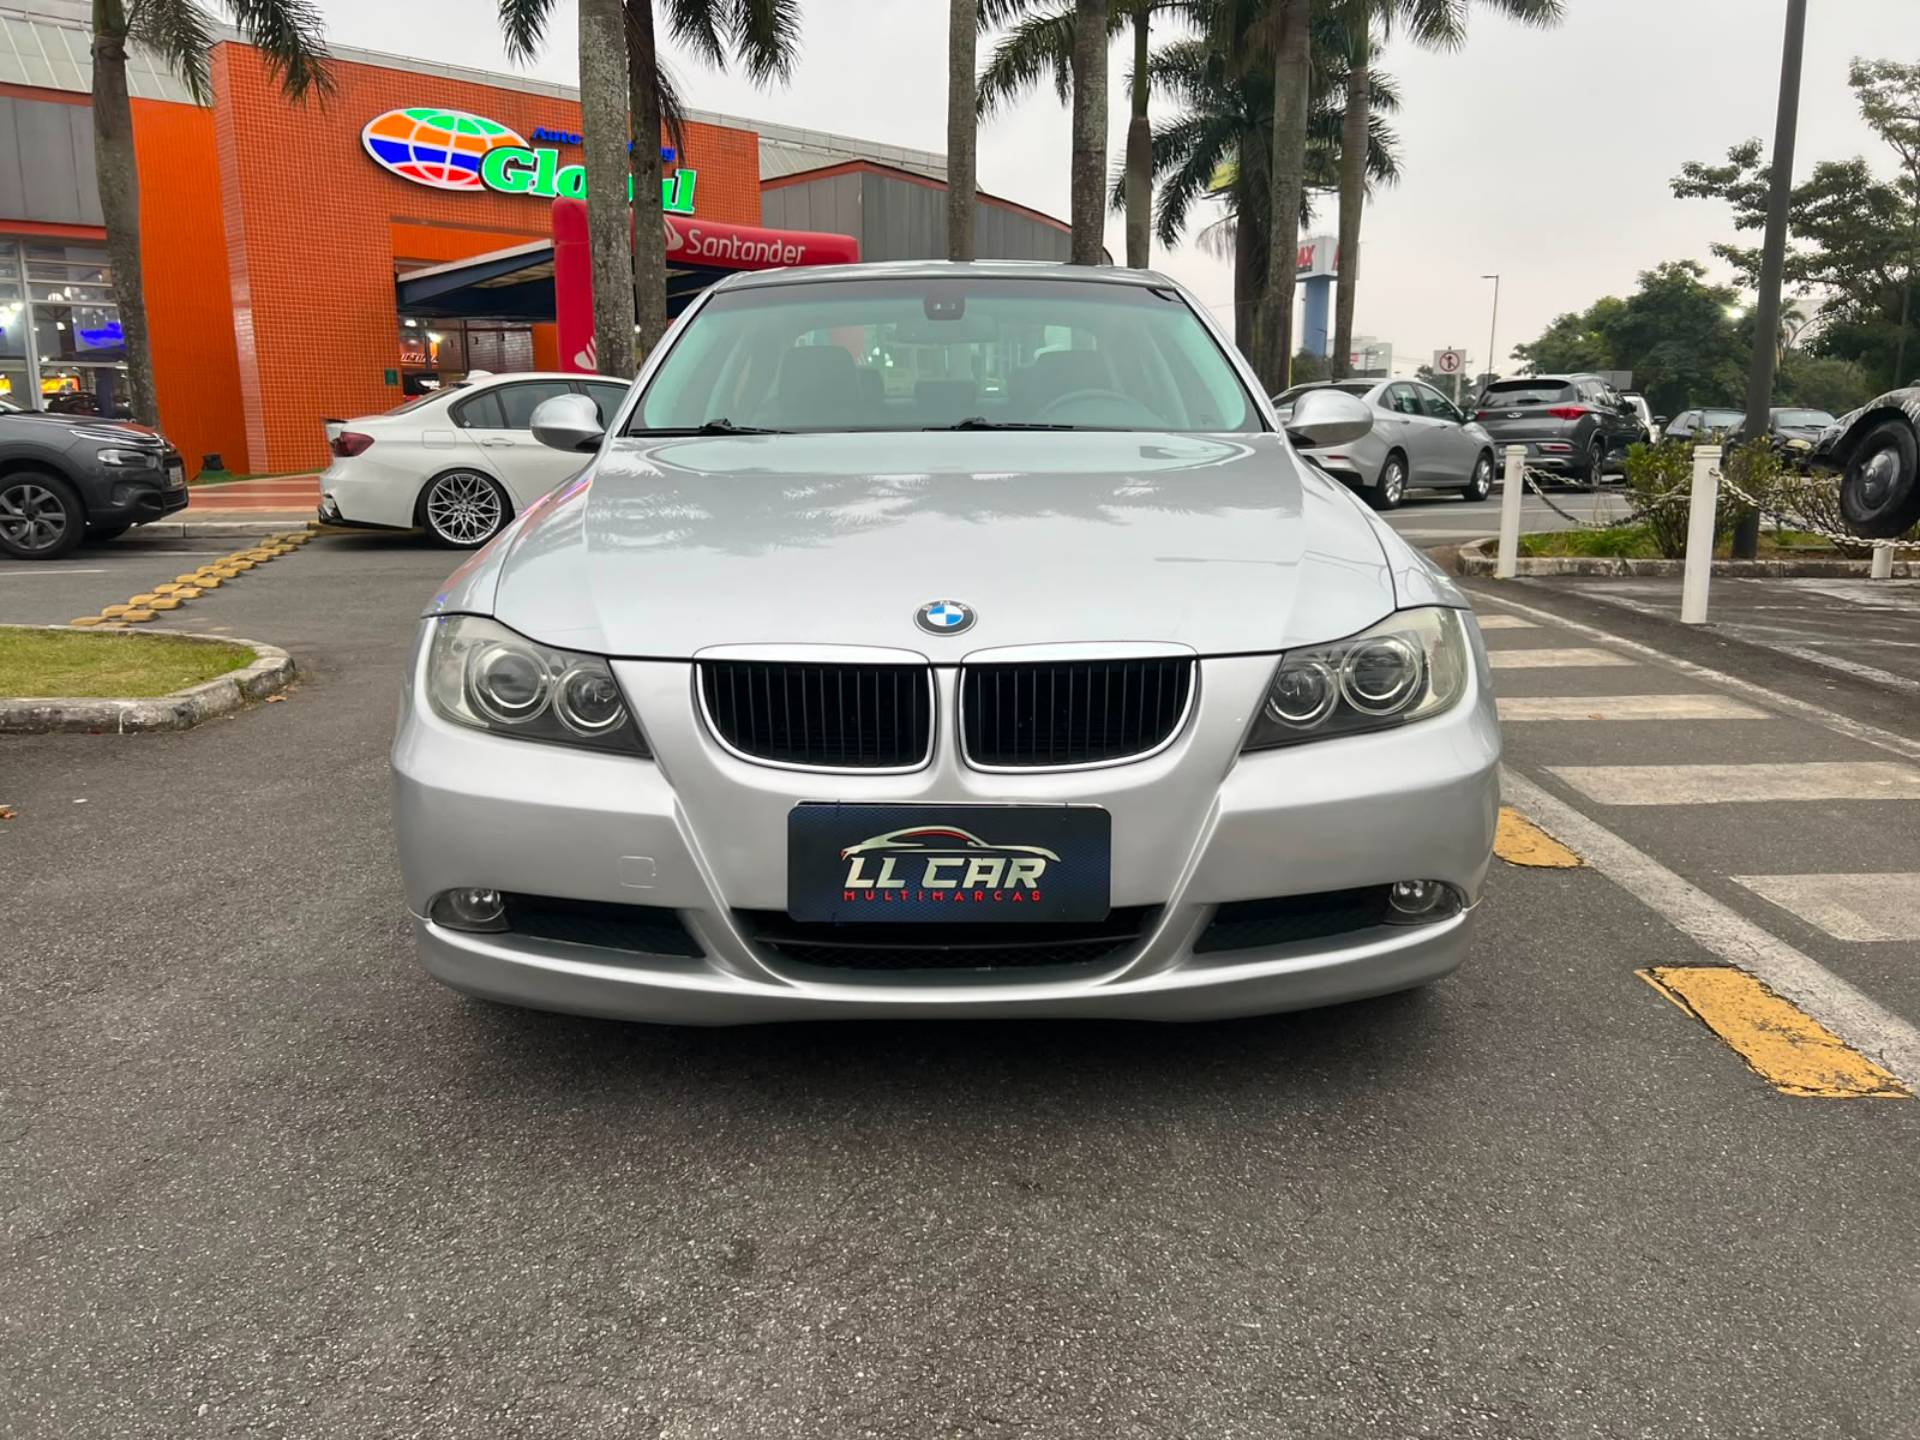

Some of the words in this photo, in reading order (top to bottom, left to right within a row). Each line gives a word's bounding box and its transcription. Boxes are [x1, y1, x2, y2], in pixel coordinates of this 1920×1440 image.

[532, 127, 583, 144] Auto
[481, 146, 697, 214] Glol
[686, 229, 806, 264] Santander
[844, 857, 905, 888] LL
[921, 857, 1046, 889] CAR
[843, 890, 1041, 901] MULTIMARCAS
